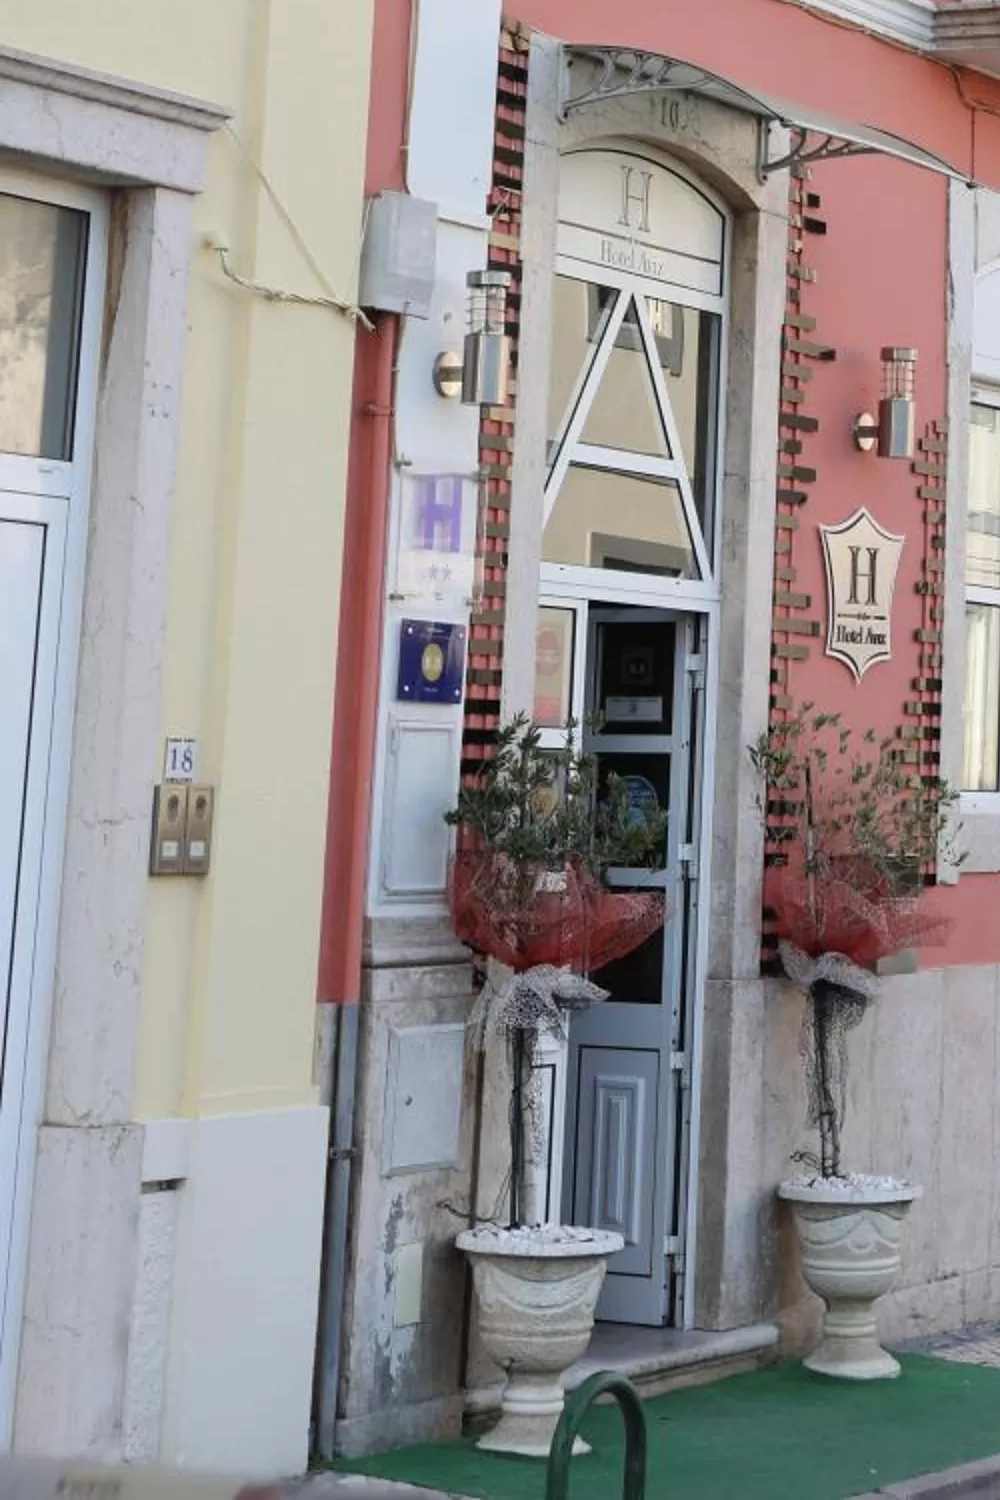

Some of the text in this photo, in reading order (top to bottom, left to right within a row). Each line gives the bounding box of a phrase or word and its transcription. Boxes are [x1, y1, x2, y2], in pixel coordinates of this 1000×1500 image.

[616, 164, 653, 233] H
[420, 476, 462, 553] H
[847, 545, 880, 607] H
